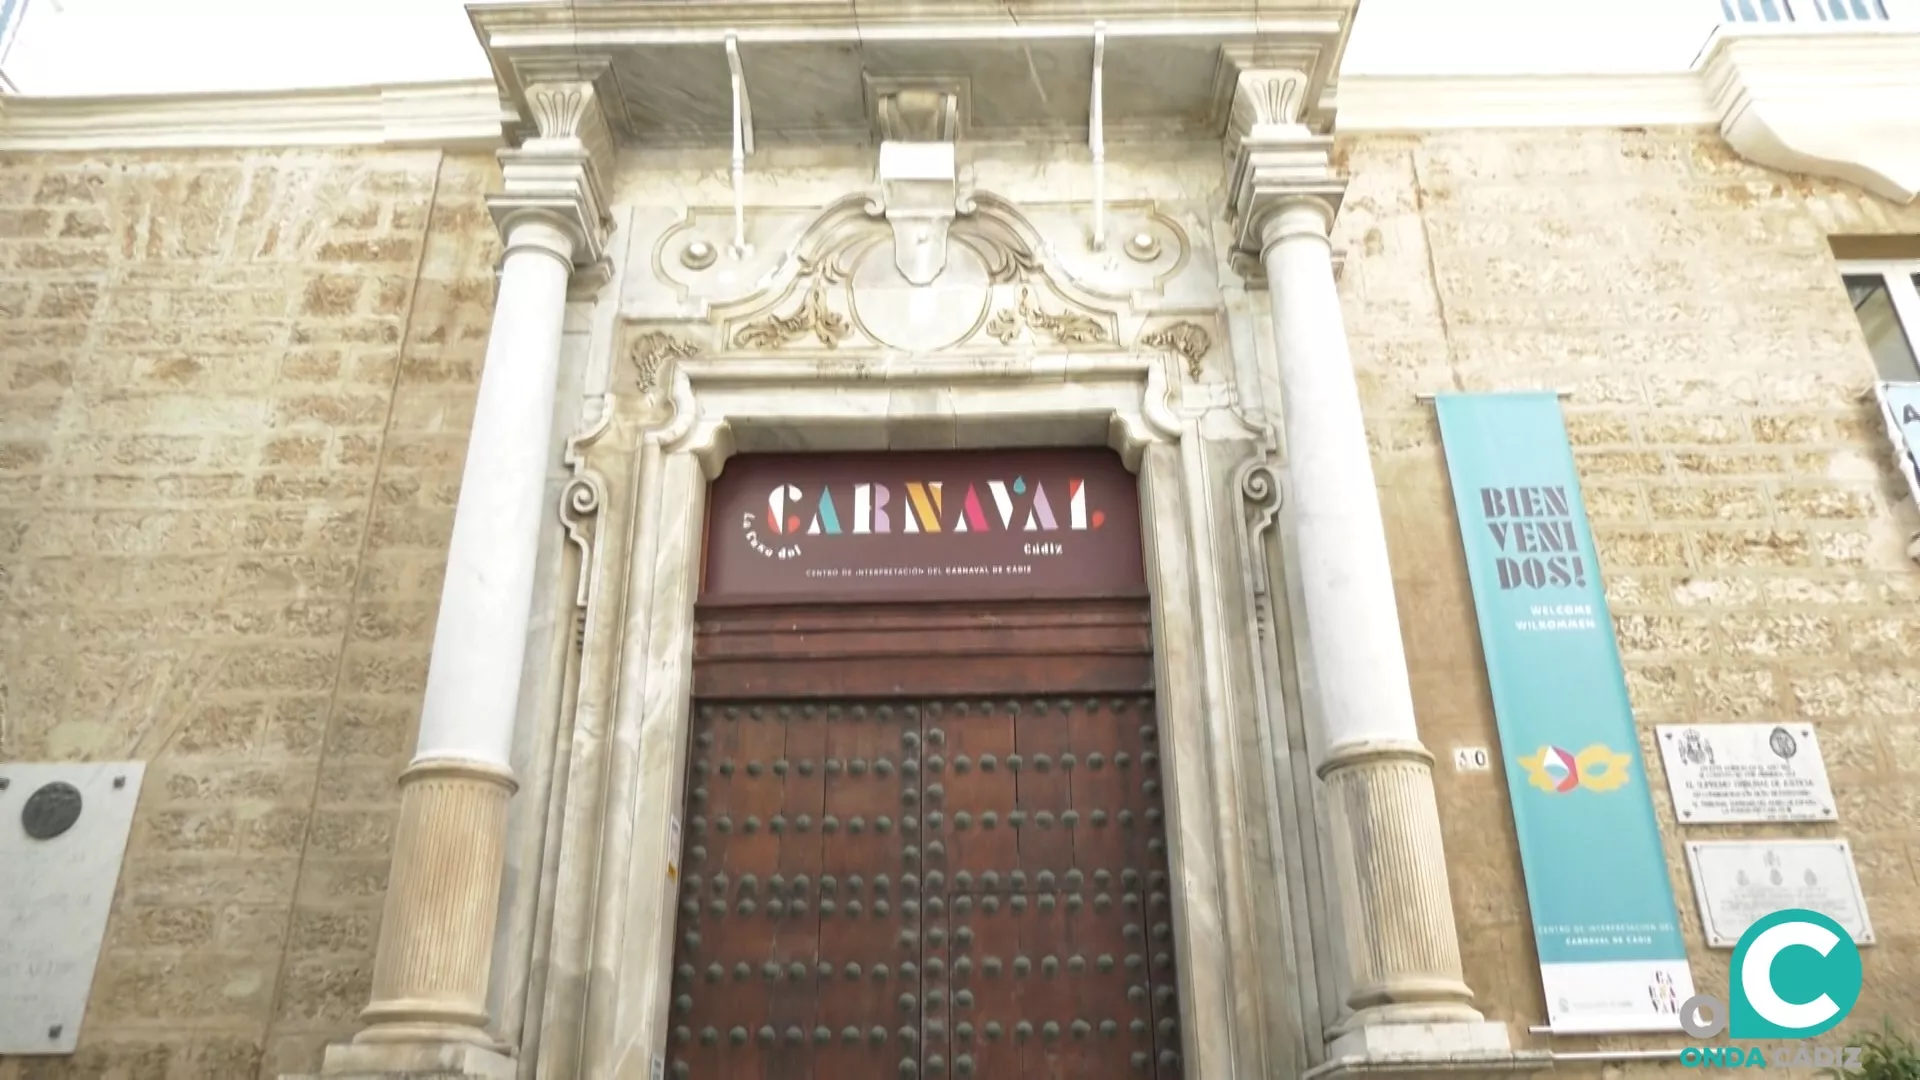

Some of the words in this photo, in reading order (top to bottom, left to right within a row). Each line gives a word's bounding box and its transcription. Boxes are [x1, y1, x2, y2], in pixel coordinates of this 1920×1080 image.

[767, 476, 1105, 535] CARNAVAL
[1481, 484, 1569, 518] BIEN
[778, 544, 801, 560] del
[1488, 520, 1578, 553] VENI
[806, 568, 838, 578] CENTRO
[842, 568, 852, 577] DE
[928, 566, 942, 576] DEL
[946, 565, 989, 575] CARNAVAL
[993, 565, 1003, 574] DE
[1496, 555, 1586, 590] DOS!
[1530, 604, 1592, 616] WELCOME
